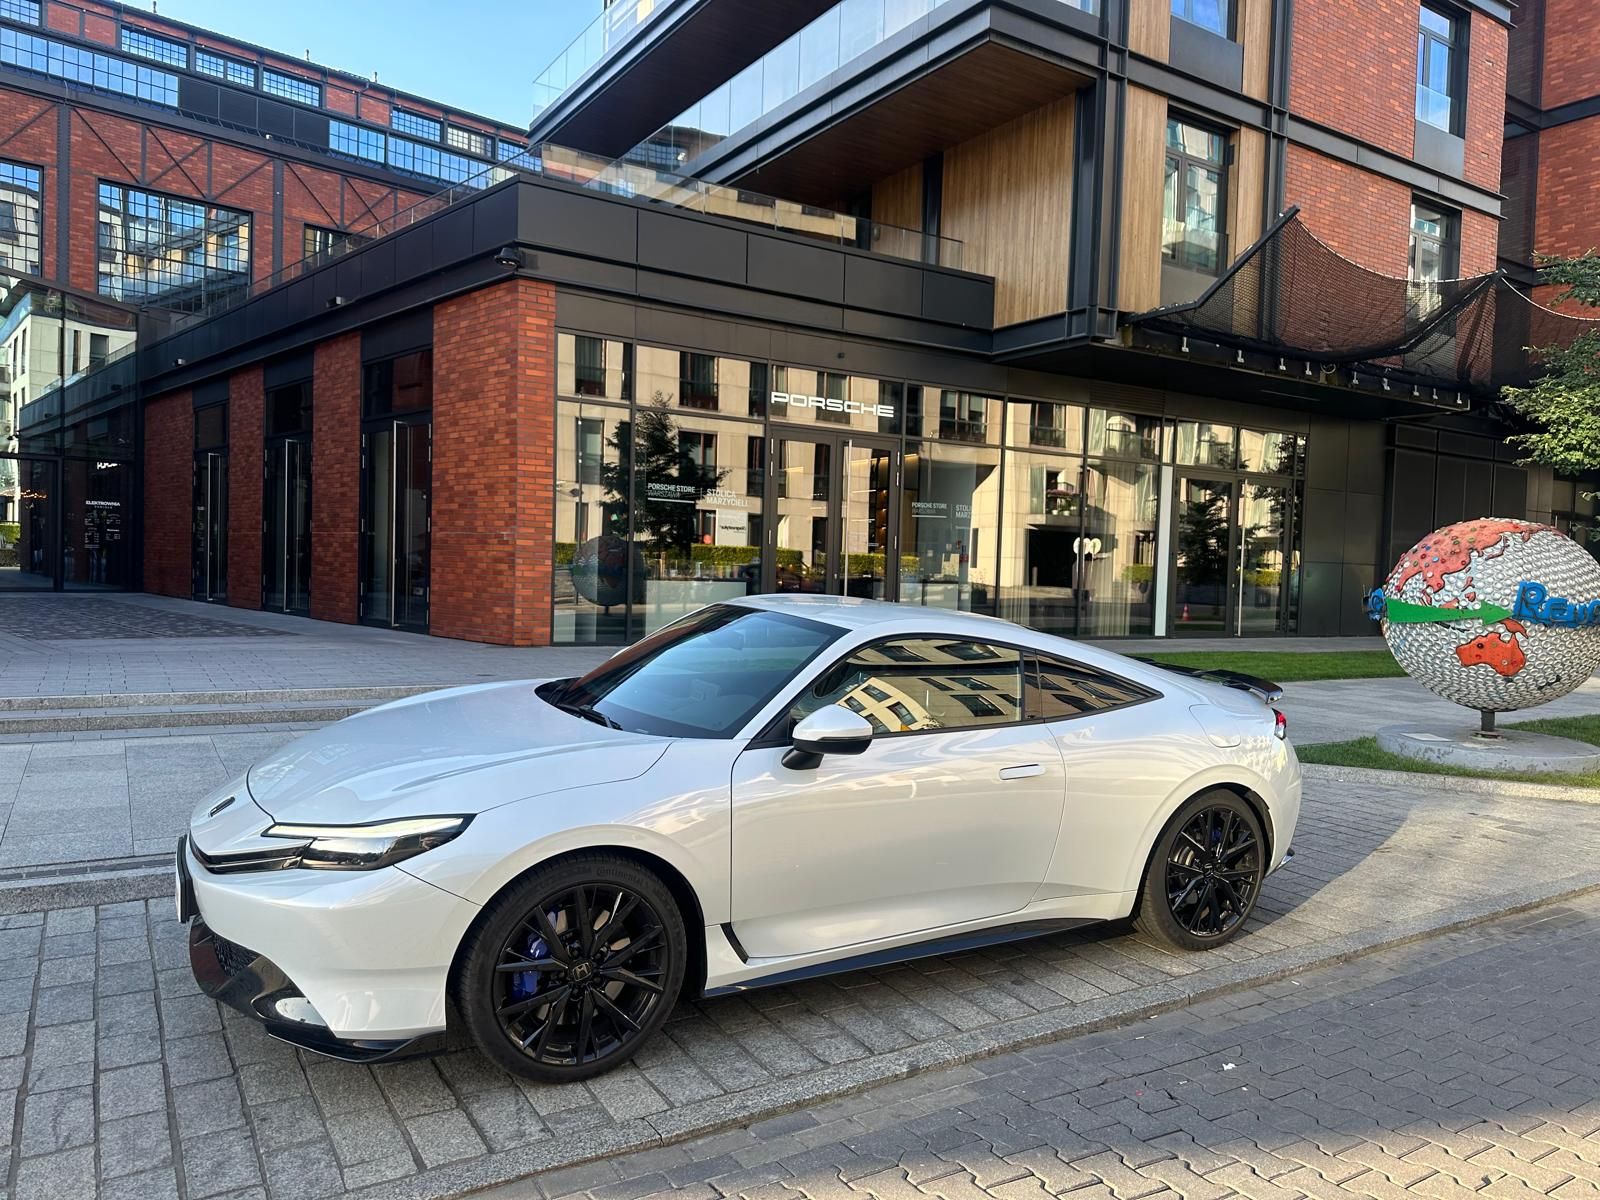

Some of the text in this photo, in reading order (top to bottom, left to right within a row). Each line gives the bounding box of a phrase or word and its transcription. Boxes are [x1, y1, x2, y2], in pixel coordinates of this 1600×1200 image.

[771, 391, 894, 418] PORSCHE
[647, 483, 696, 494] PORSCHE STORE
[706, 488, 737, 498] STOLICA
